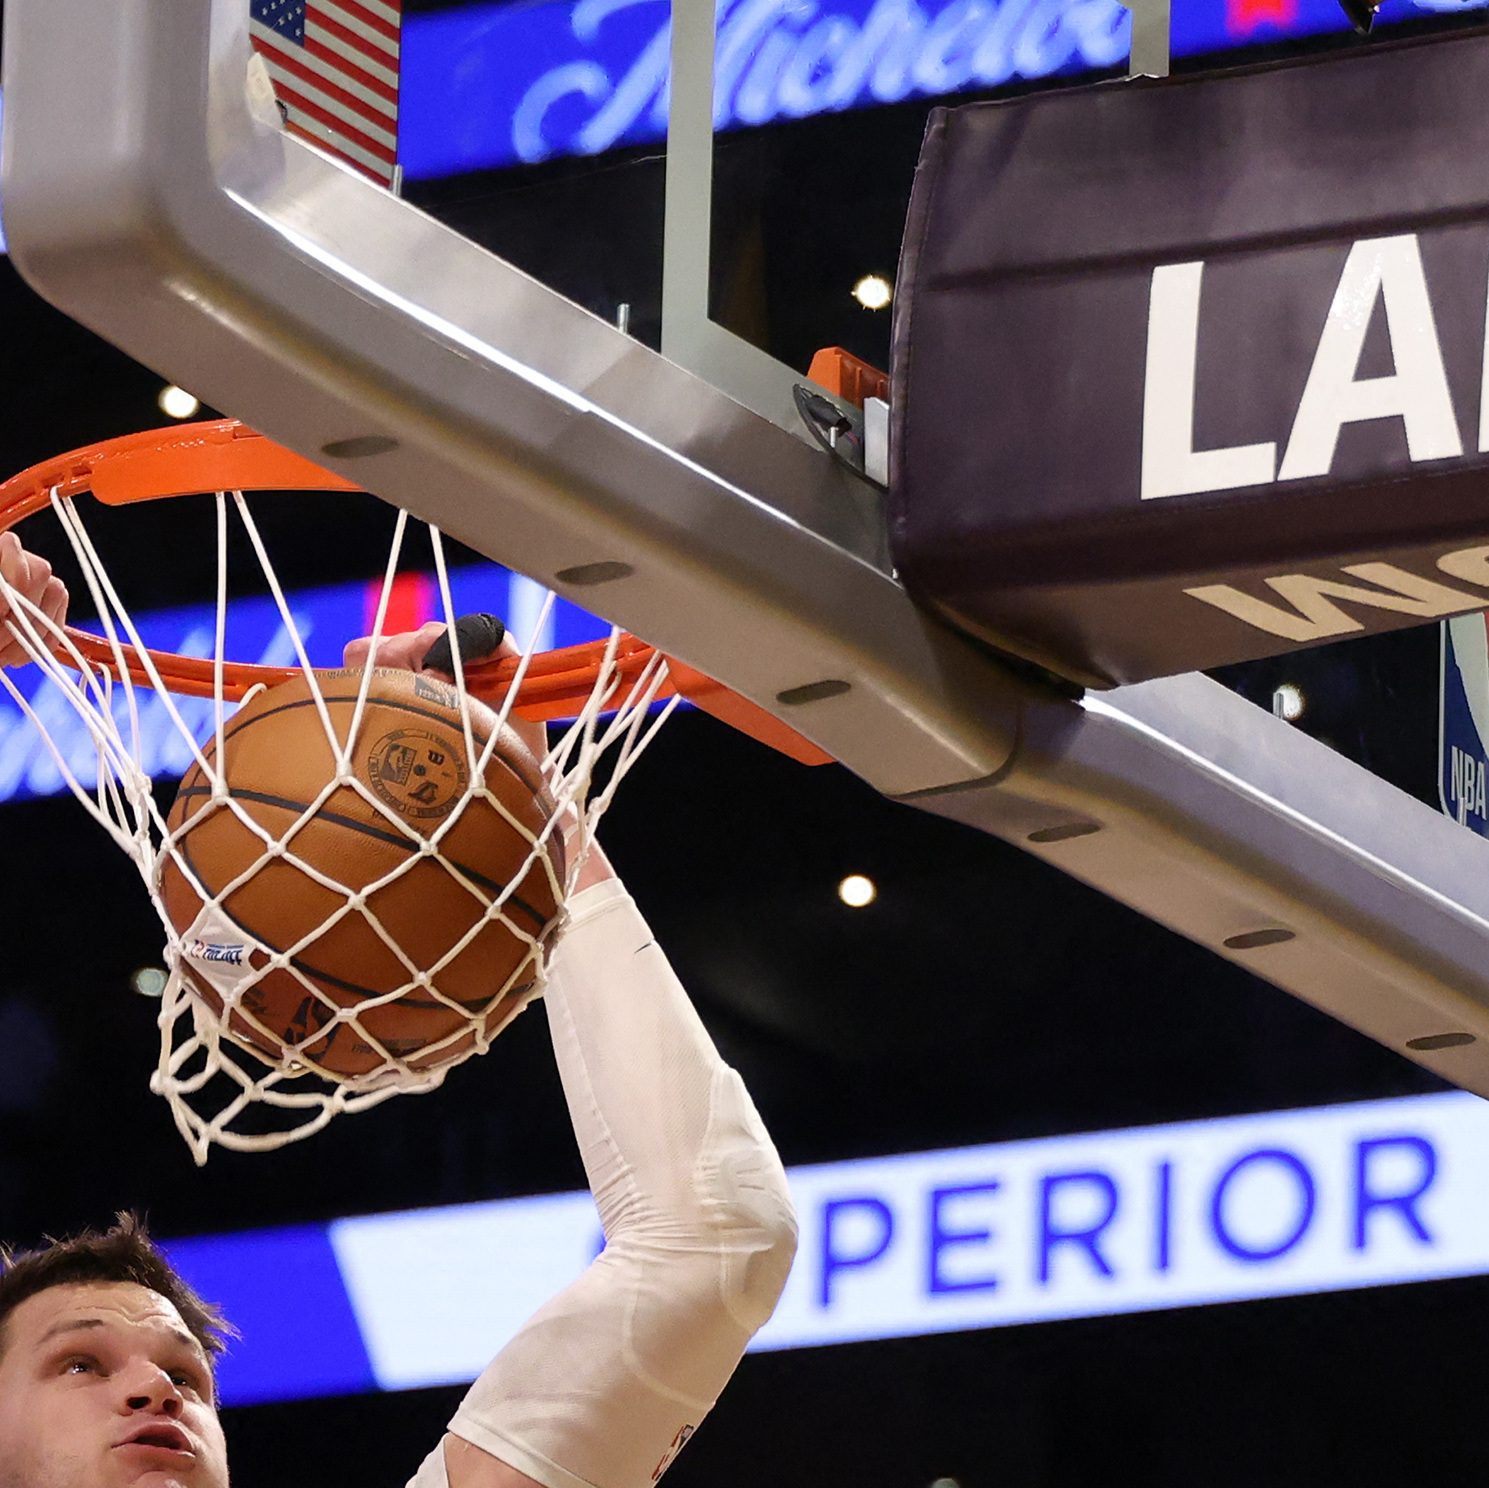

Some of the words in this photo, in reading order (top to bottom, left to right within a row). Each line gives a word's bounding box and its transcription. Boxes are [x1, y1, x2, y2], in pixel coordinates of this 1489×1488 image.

[1140, 233, 1489, 500] LA
[1451, 745, 1488, 820] NBA
[592, 1131, 1440, 1311] PERIOR
